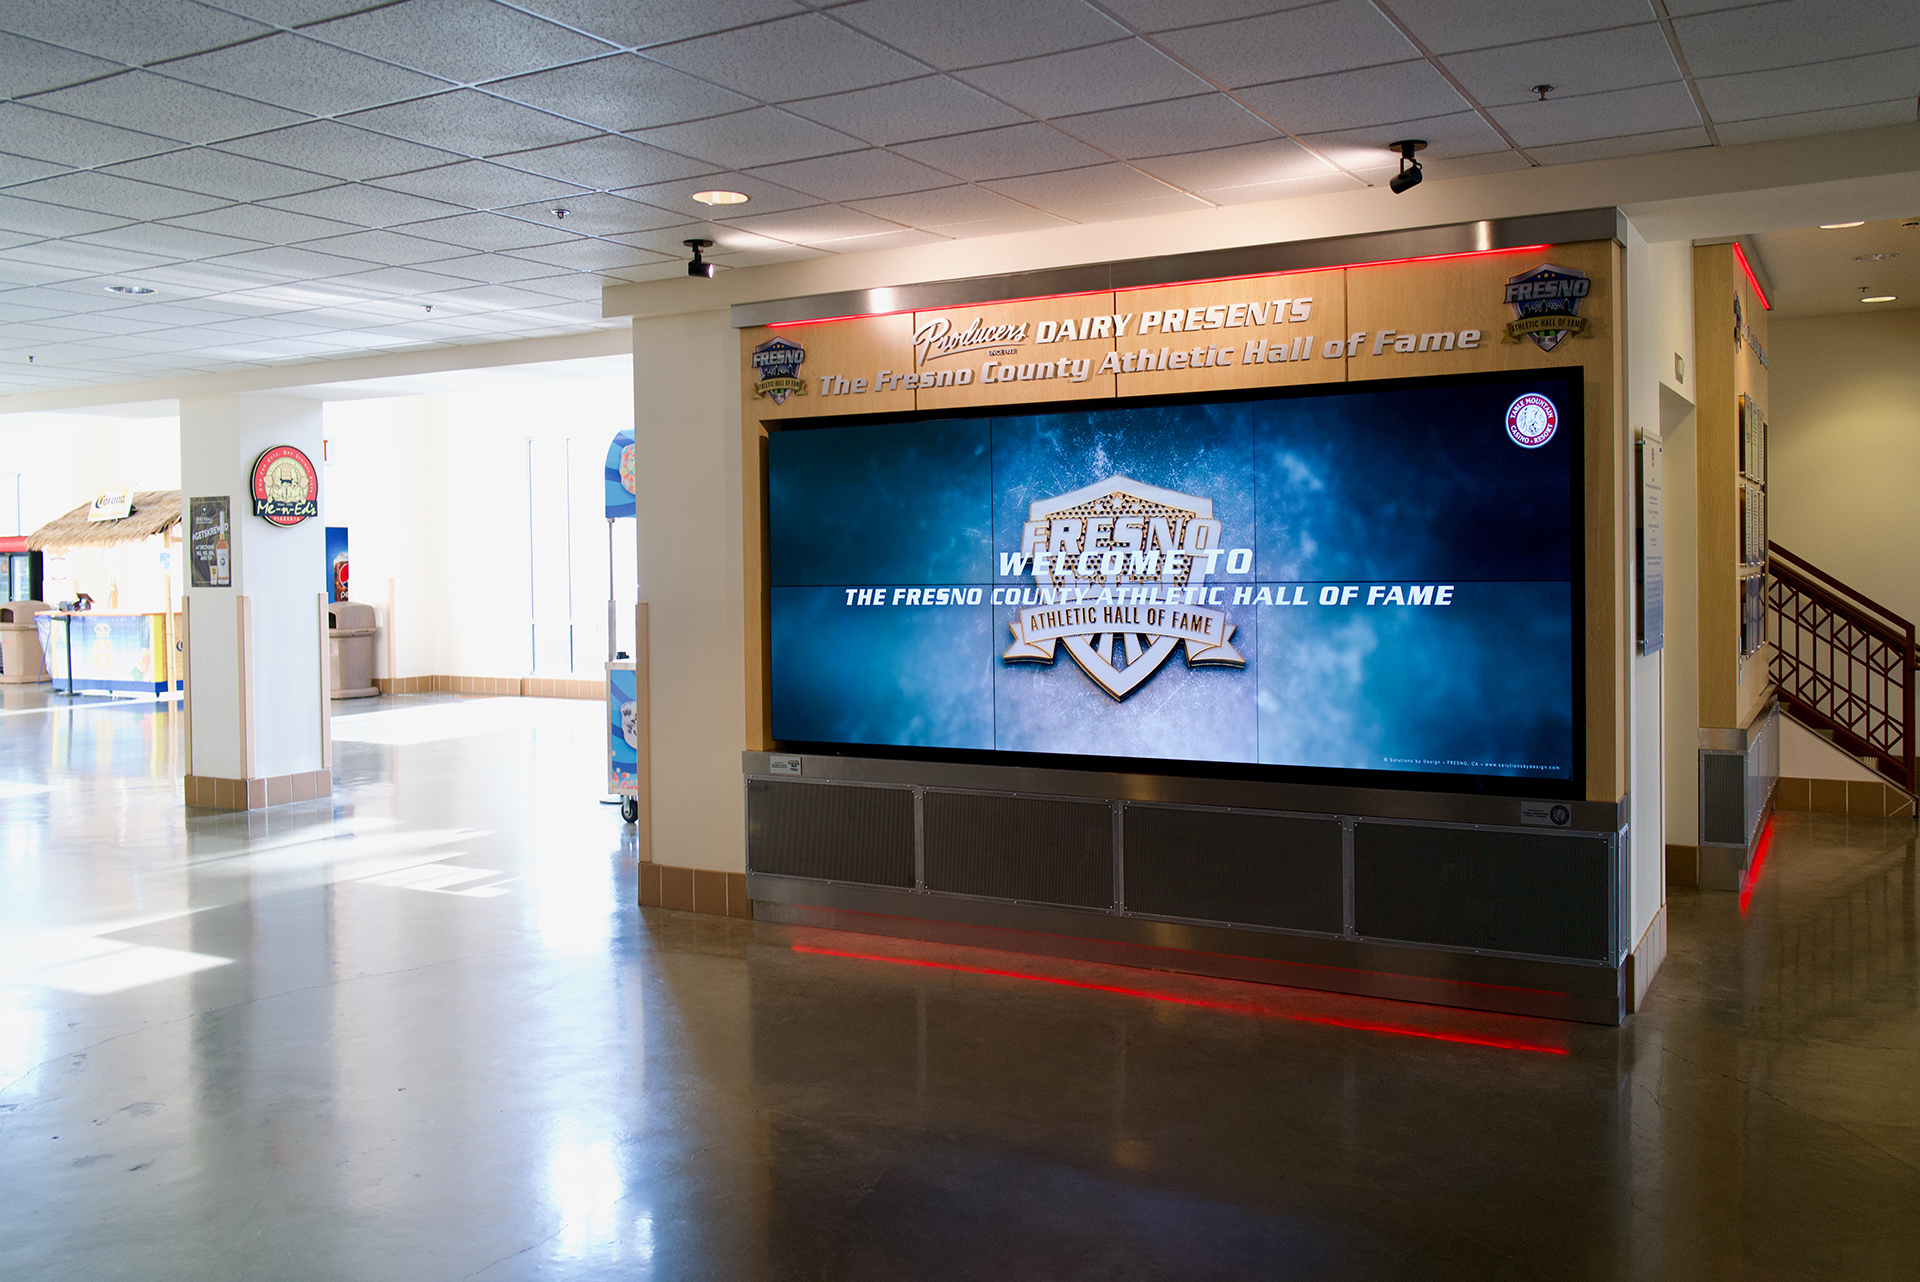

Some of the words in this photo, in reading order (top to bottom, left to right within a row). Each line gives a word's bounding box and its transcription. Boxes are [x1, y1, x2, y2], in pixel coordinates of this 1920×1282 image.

[1504, 278, 1590, 304] FRESNO
[912, 317, 1029, 367] Producers
[1035, 313, 1133, 345] DAIRY
[1138, 297, 1313, 335] PRESENTS
[1511, 321, 1539, 333] ATHLETIC
[1540, 318, 1556, 327] HALL
[1557, 318, 1566, 327] OF
[1567, 319, 1584, 329] FAME
[752, 349, 805, 368] FRESNO
[820, 374, 868, 396] The
[874, 367, 974, 393] Fresno
[980, 355, 1090, 383] County
[1098, 344, 1235, 375] Athletic
[1242, 335, 1314, 365] Hall
[1322, 331, 1367, 359] of
[1372, 329, 1482, 356] Fame
[1510, 400, 1526, 419] TABLE
[1525, 397, 1554, 419] MOUNTAIN
[1510, 424, 1530, 444] CASINO
[1533, 423, 1553, 444] RESORT
[95, 495, 126, 509] Corona
[257, 500, 316, 515] Me-n-Ed's
[1021, 516, 1222, 559] FRESNO
[1000, 549, 1187, 576] WELCOME
[1203, 548, 1253, 574] TO
[845, 588, 887, 606] THE
[892, 587, 983, 606] FRESNO
[990, 587, 1090, 606] COUNTY
[1095, 586, 1224, 606] ATHLETIC
[1233, 586, 1309, 606] HALL
[1319, 585, 1359, 606] OF
[1366, 585, 1454, 606] FAME
[1030, 606, 1097, 632] ATHLETIC
[1103, 606, 1140, 624] HALL
[1147, 607, 1166, 626] OF
[1171, 610, 1213, 635] FAME
[1422, 758, 1441, 766] Design
[1484, 762, 1560, 771] www.solutionsbydesign.com
